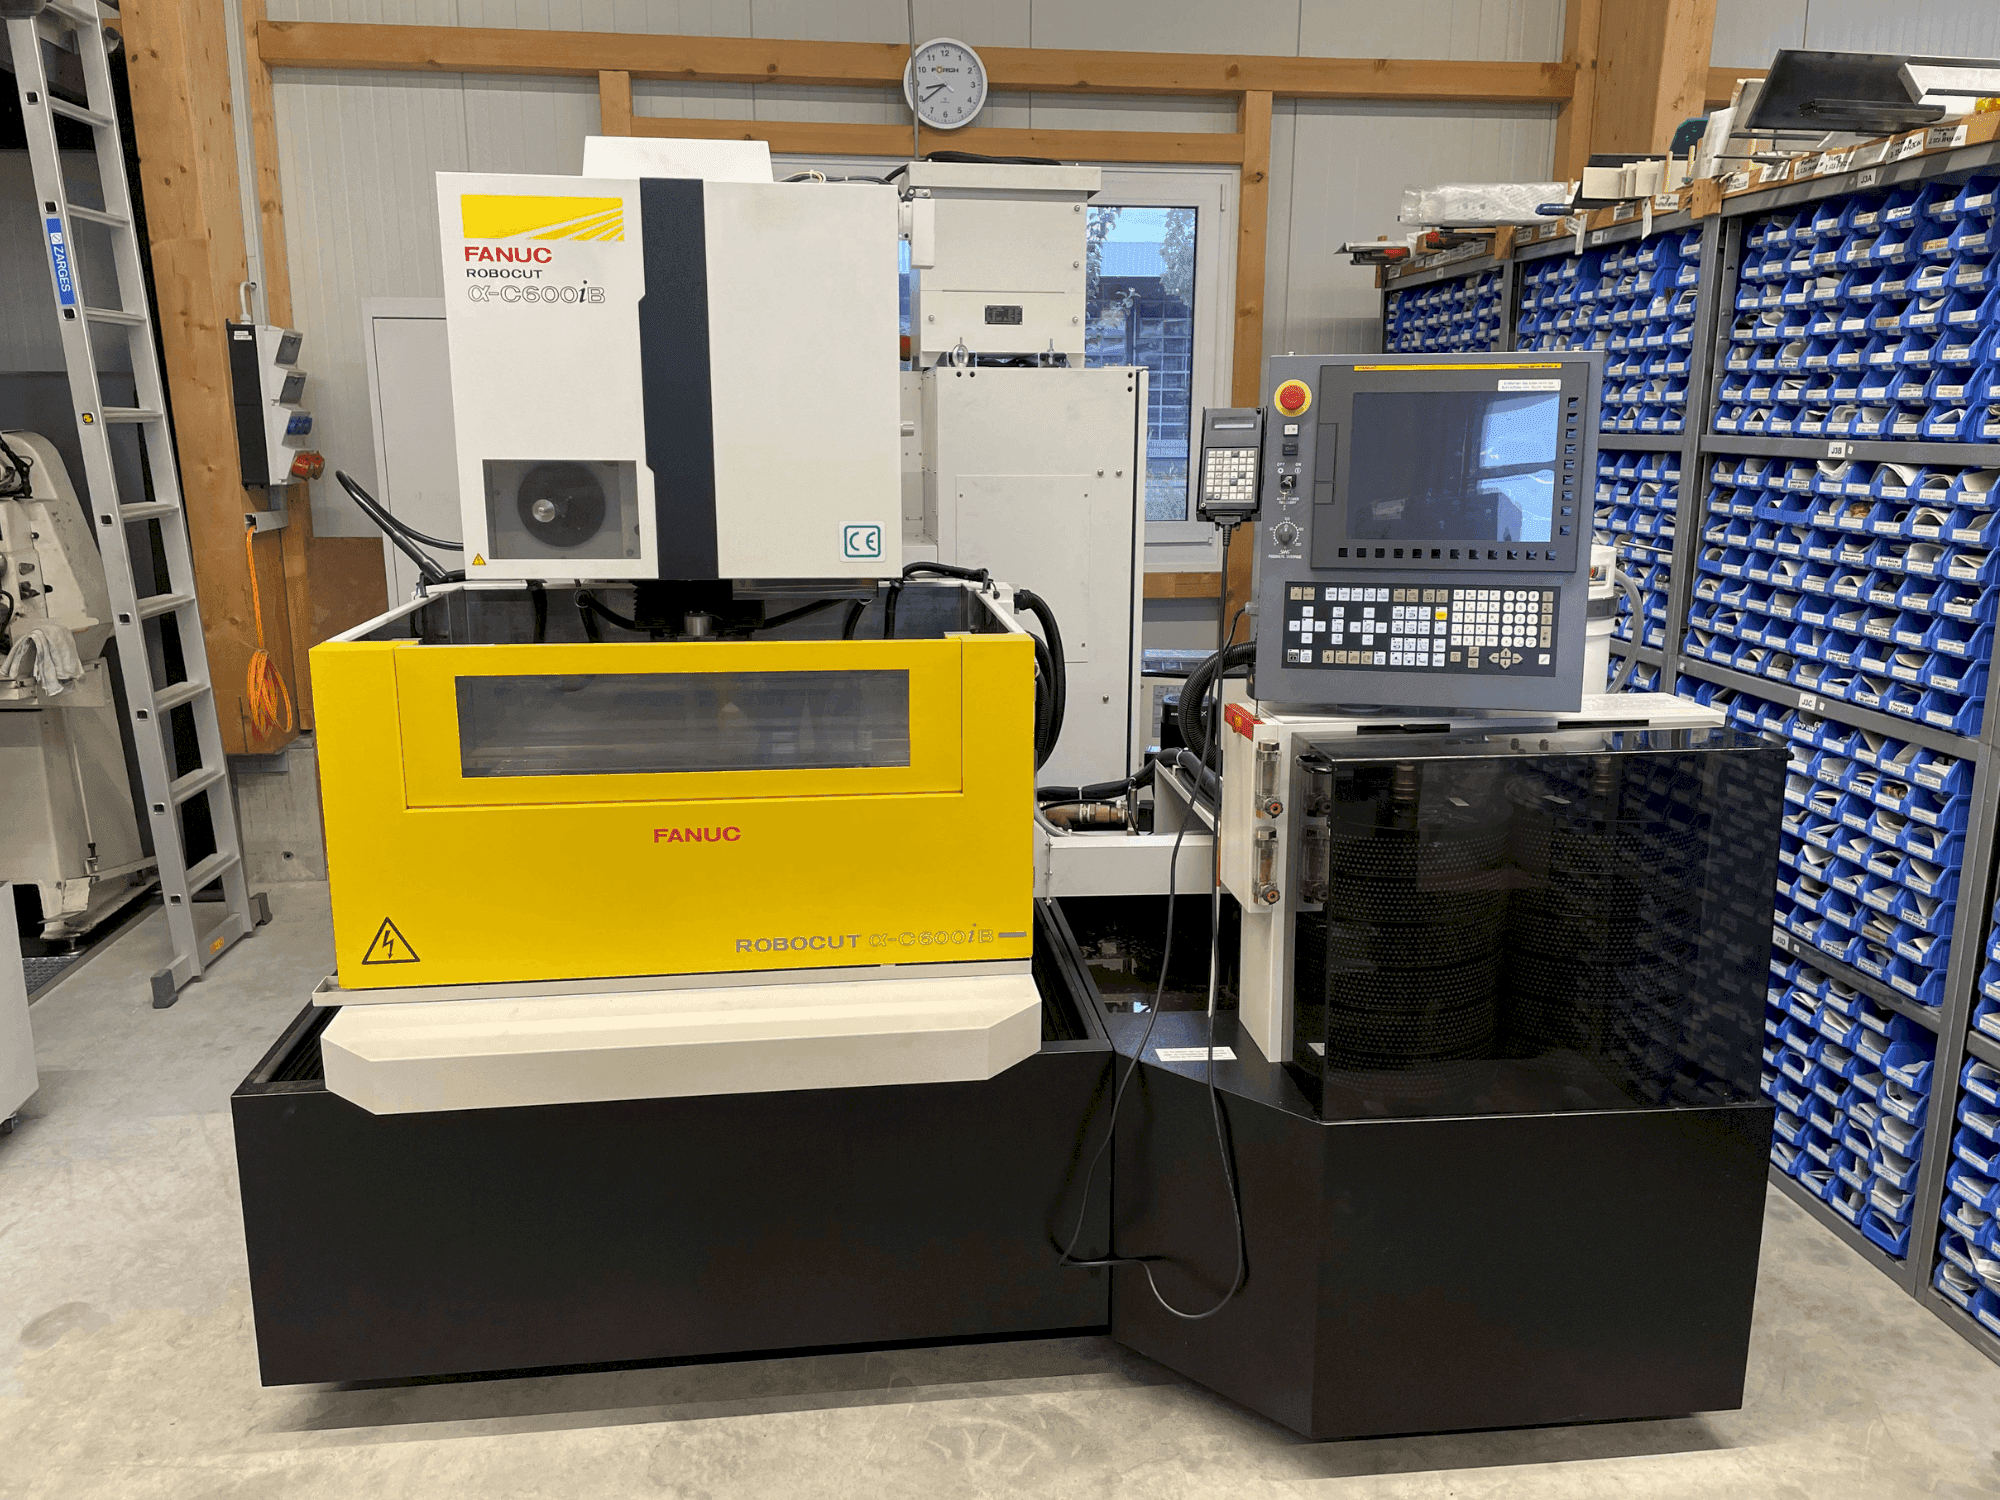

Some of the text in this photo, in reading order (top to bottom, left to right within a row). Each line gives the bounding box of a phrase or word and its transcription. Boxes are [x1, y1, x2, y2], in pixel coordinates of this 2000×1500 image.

[464, 246, 553, 264] FANUC
[53, 245, 71, 292] ZARGES
[466, 268, 542, 279] ROBOCUT
[849, 531, 876, 551] CE
[653, 826, 742, 844] FANUC
[735, 933, 861, 953] ROBOCUT
